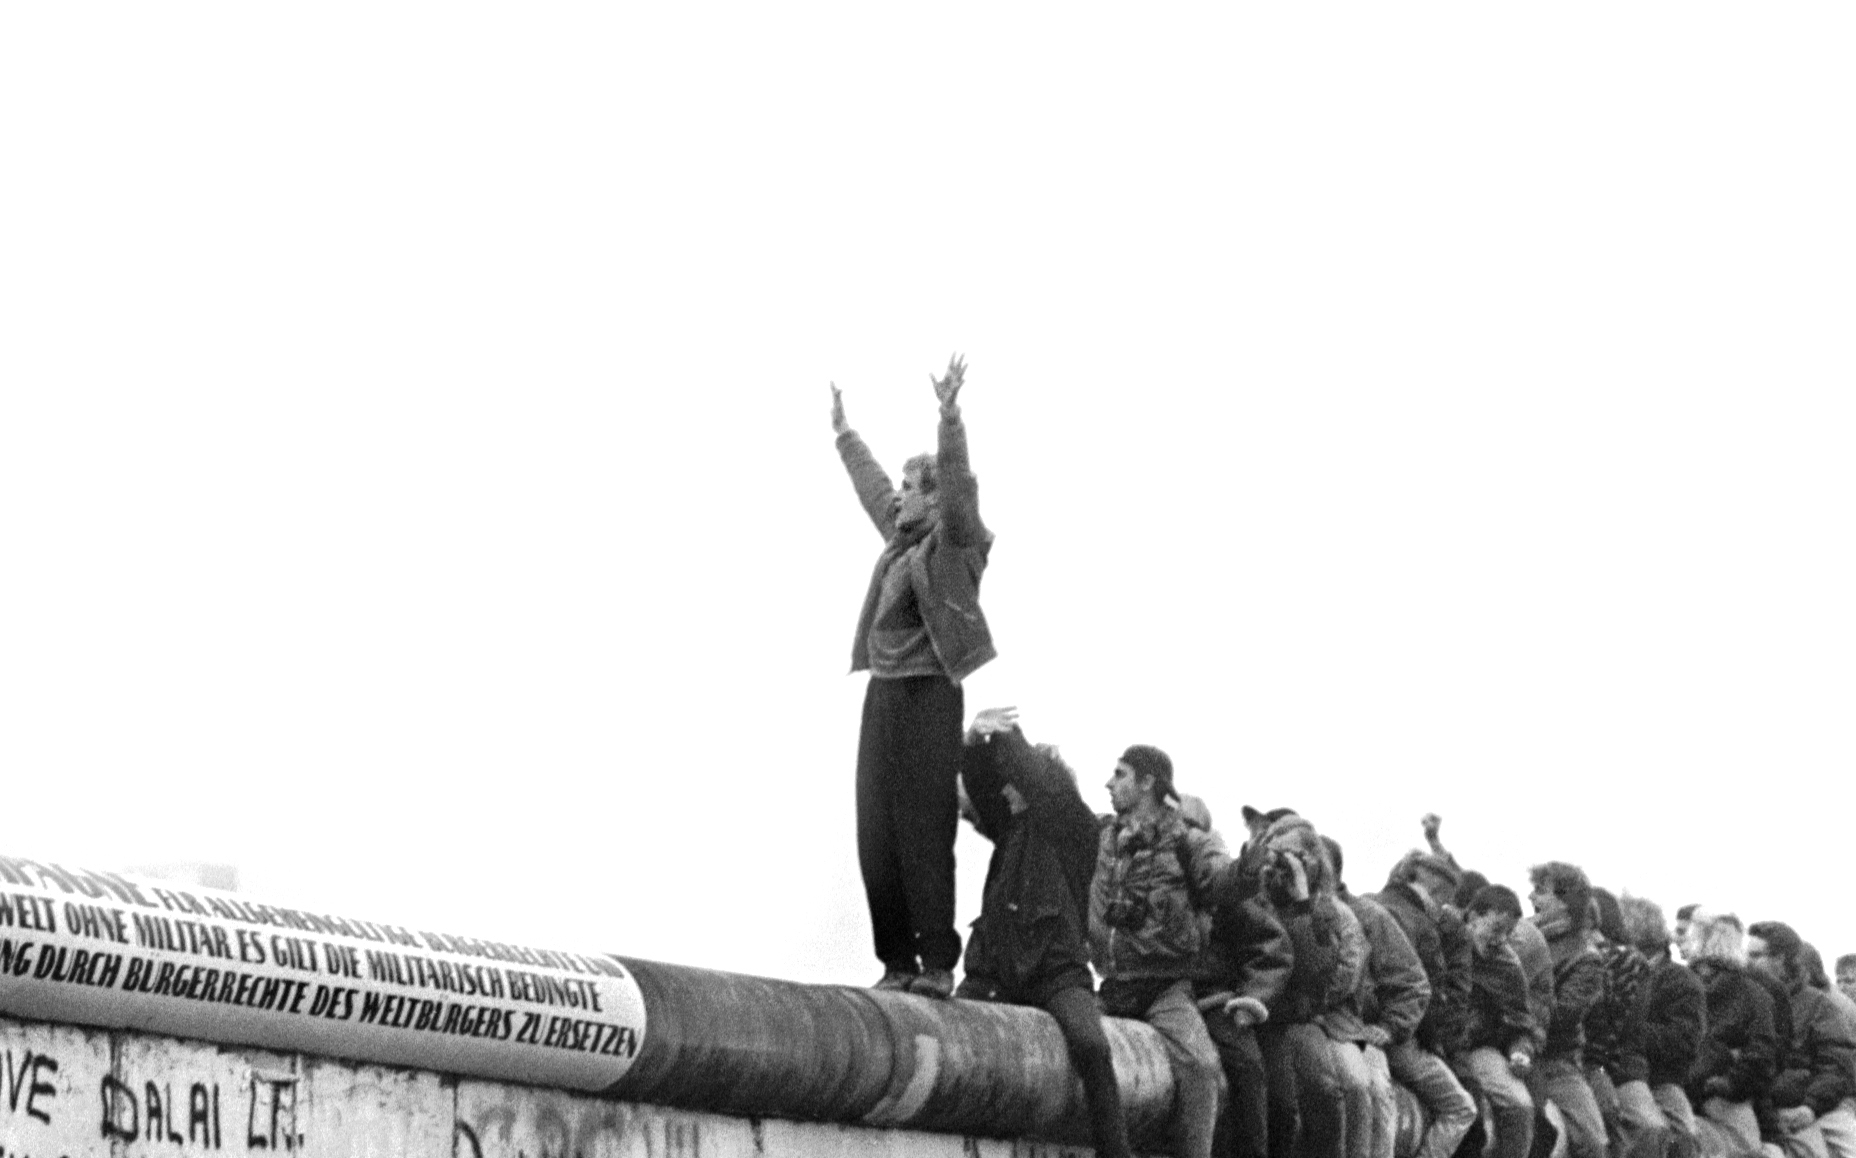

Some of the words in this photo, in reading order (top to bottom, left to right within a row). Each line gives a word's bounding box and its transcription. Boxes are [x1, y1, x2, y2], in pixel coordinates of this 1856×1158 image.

[34, 944, 121, 988] DURCH
[308, 984, 360, 1021] DES
[516, 1012, 548, 1045] ZU
[543, 1017, 639, 1060] ERSETZEN
[65, 901, 130, 944] OHNE
[236, 929, 265, 965] ES
[270, 934, 318, 973] GILT
[323, 940, 362, 979] DIE
[507, 972, 604, 1013] BEDINGTE
[99, 1074, 220, 1149] DALAI
